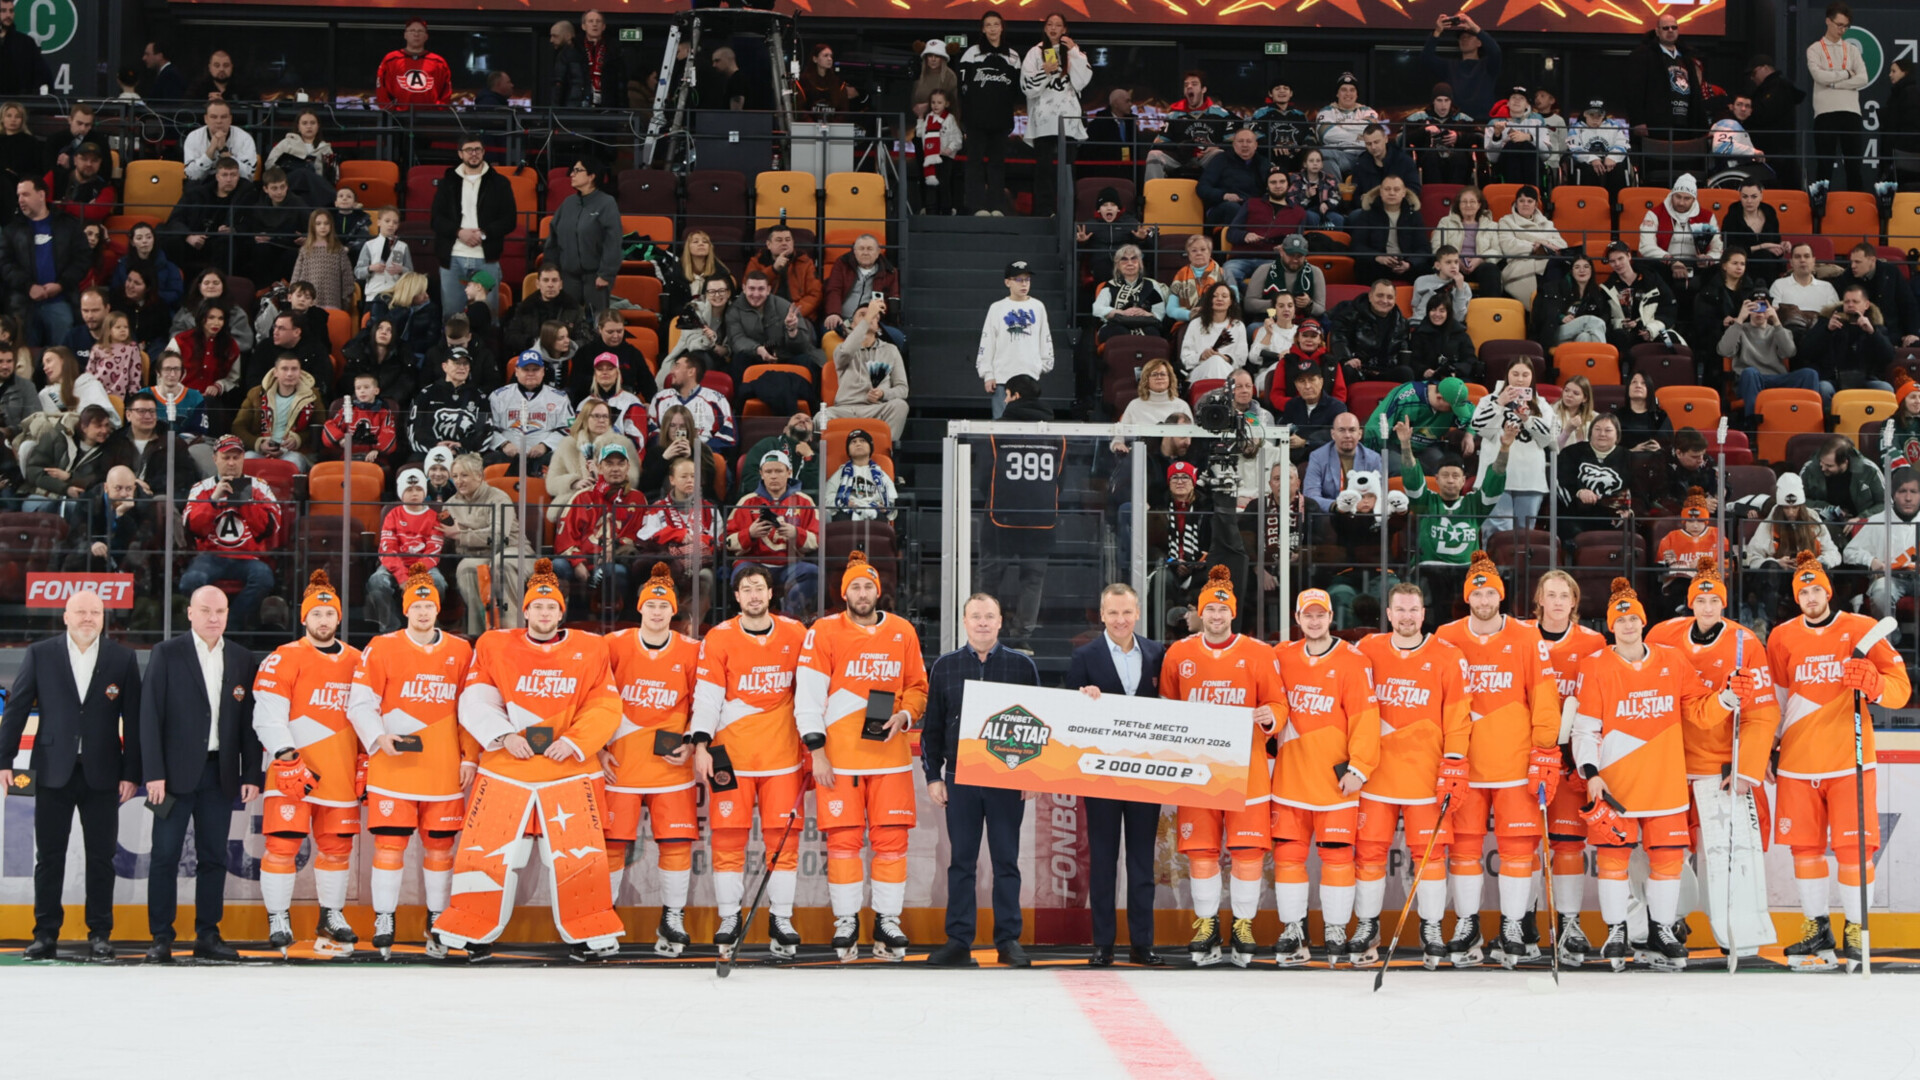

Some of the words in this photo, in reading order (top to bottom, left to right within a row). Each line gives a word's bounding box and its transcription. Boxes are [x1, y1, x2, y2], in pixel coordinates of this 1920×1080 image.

[54, 63, 73, 94] 4
[410, 70, 424, 86] A
[1863, 100, 1880, 131] 3
[1862, 138, 1880, 169] 4
[1005, 452, 1054, 481] 399
[220, 510, 238, 537] A
[845, 660, 868, 677] ALL
[872, 661, 901, 678] STAR
[1750, 665, 1771, 690] 35
[1794, 664, 1816, 682] ALL
[1818, 661, 1845, 679] STA
[515, 675, 538, 692] ALL
[543, 677, 577, 694] STAR
[738, 674, 762, 691] ALL
[765, 671, 793, 688] STAR
[1480, 672, 1513, 688] STAR
[309, 689, 333, 706] ALL
[337, 690, 350, 707] ST
[400, 681, 424, 698] ALL
[429, 682, 457, 700] STAR
[620, 685, 643, 701] ALL
[647, 687, 678, 707] STAR
[1188, 688, 1210, 703] ALL
[1214, 688, 1247, 704] STAR
[1398, 686, 1431, 706] STAR
[1303, 693, 1335, 713] STAR
[1615, 699, 1639, 717] ALL
[1642, 695, 1674, 713] STAR
[999, 713, 1033, 724] FONBET
[1113, 719, 1152, 730] ТРЕТЬЕ
[1154, 723, 1189, 733] МЕСТО
[981, 722, 1007, 740] ALL
[1013, 724, 1050, 745] STAR
[1067, 725, 1111, 736] ФОНБЕТ
[1112, 729, 1147, 740] МАТЧА
[1149, 732, 1182, 744] ЗВЕЗД
[1184, 736, 1206, 746] КХЛ
[1206, 738, 1232, 748] 2026
[1095, 759, 1106, 770] 2
[1109, 760, 1142, 774] 000
[1144, 764, 1178, 777] 000
[1051, 794, 1077, 900] FONBE
